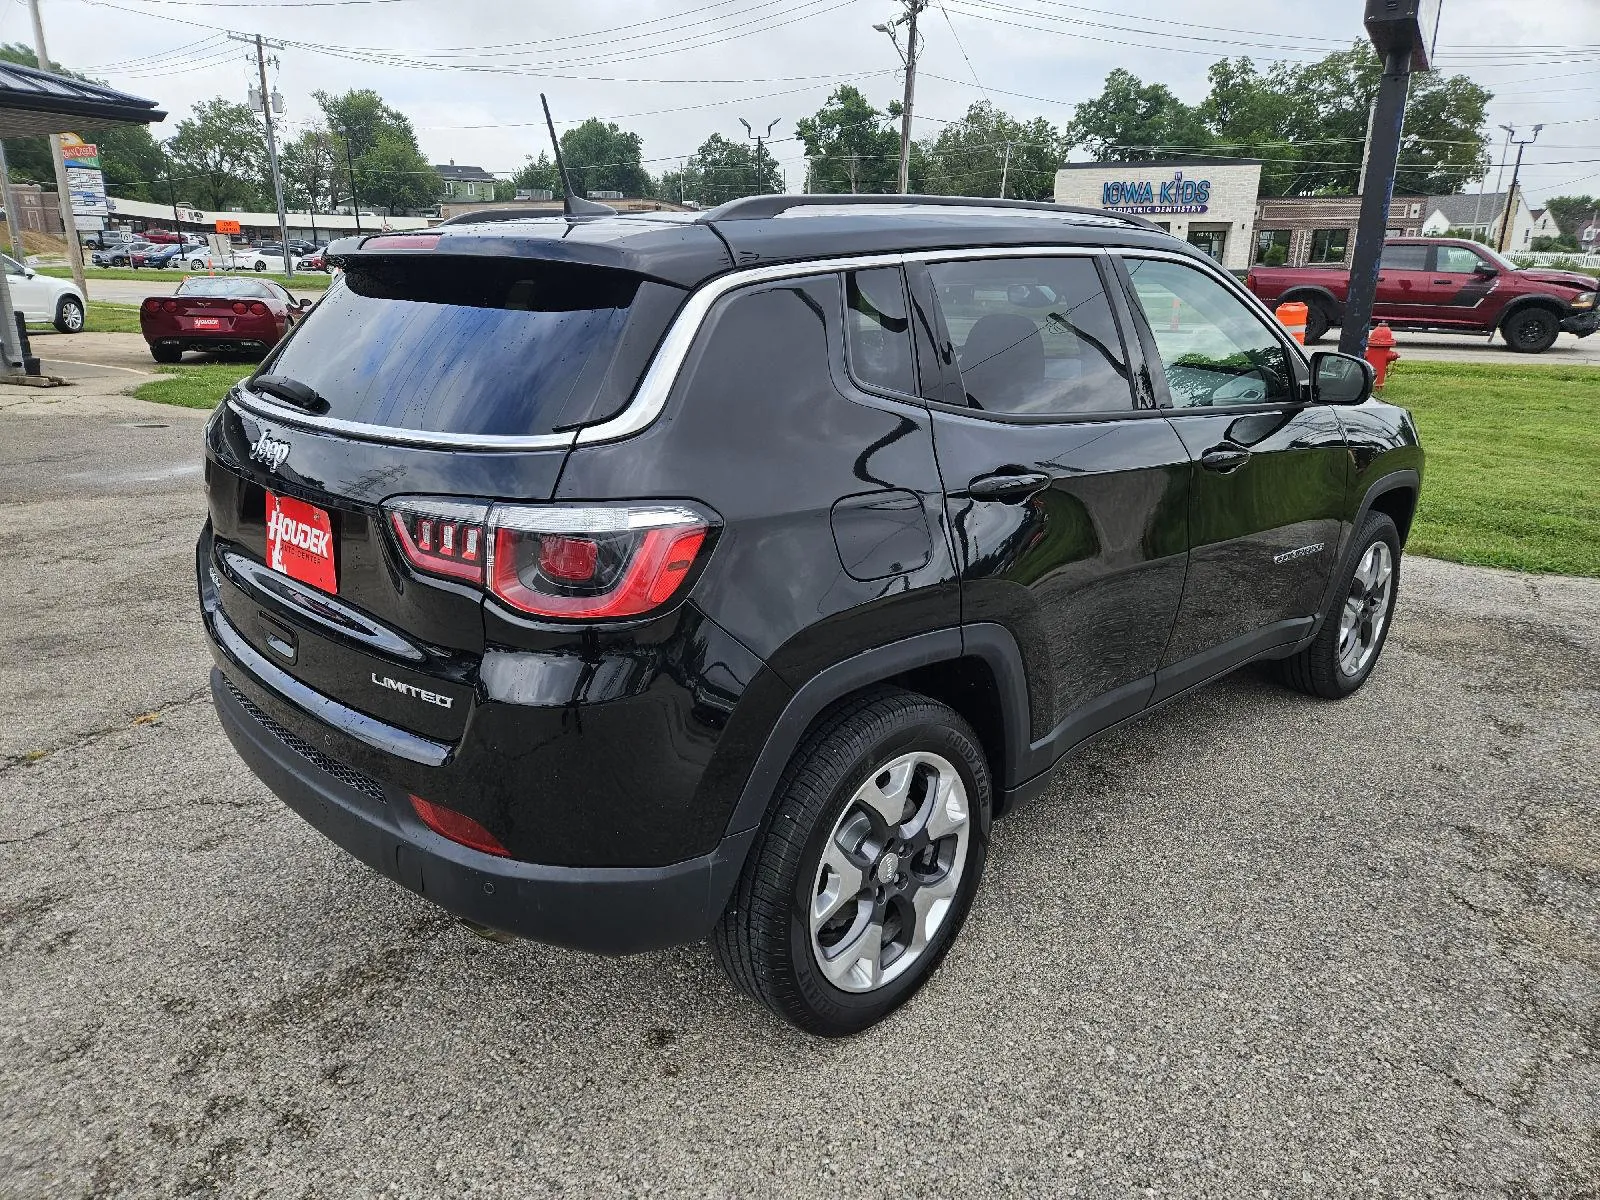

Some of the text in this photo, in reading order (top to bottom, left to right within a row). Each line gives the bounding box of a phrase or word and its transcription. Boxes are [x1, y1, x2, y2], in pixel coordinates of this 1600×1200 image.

[1102, 182, 1153, 204] IOWA
[1155, 205, 1202, 213] DENTISTRY
[249, 430, 291, 473] Jeep
[267, 510, 332, 558] HOUDEK
[297, 550, 321, 565] CENTER
[371, 672, 454, 709] LIMITED
